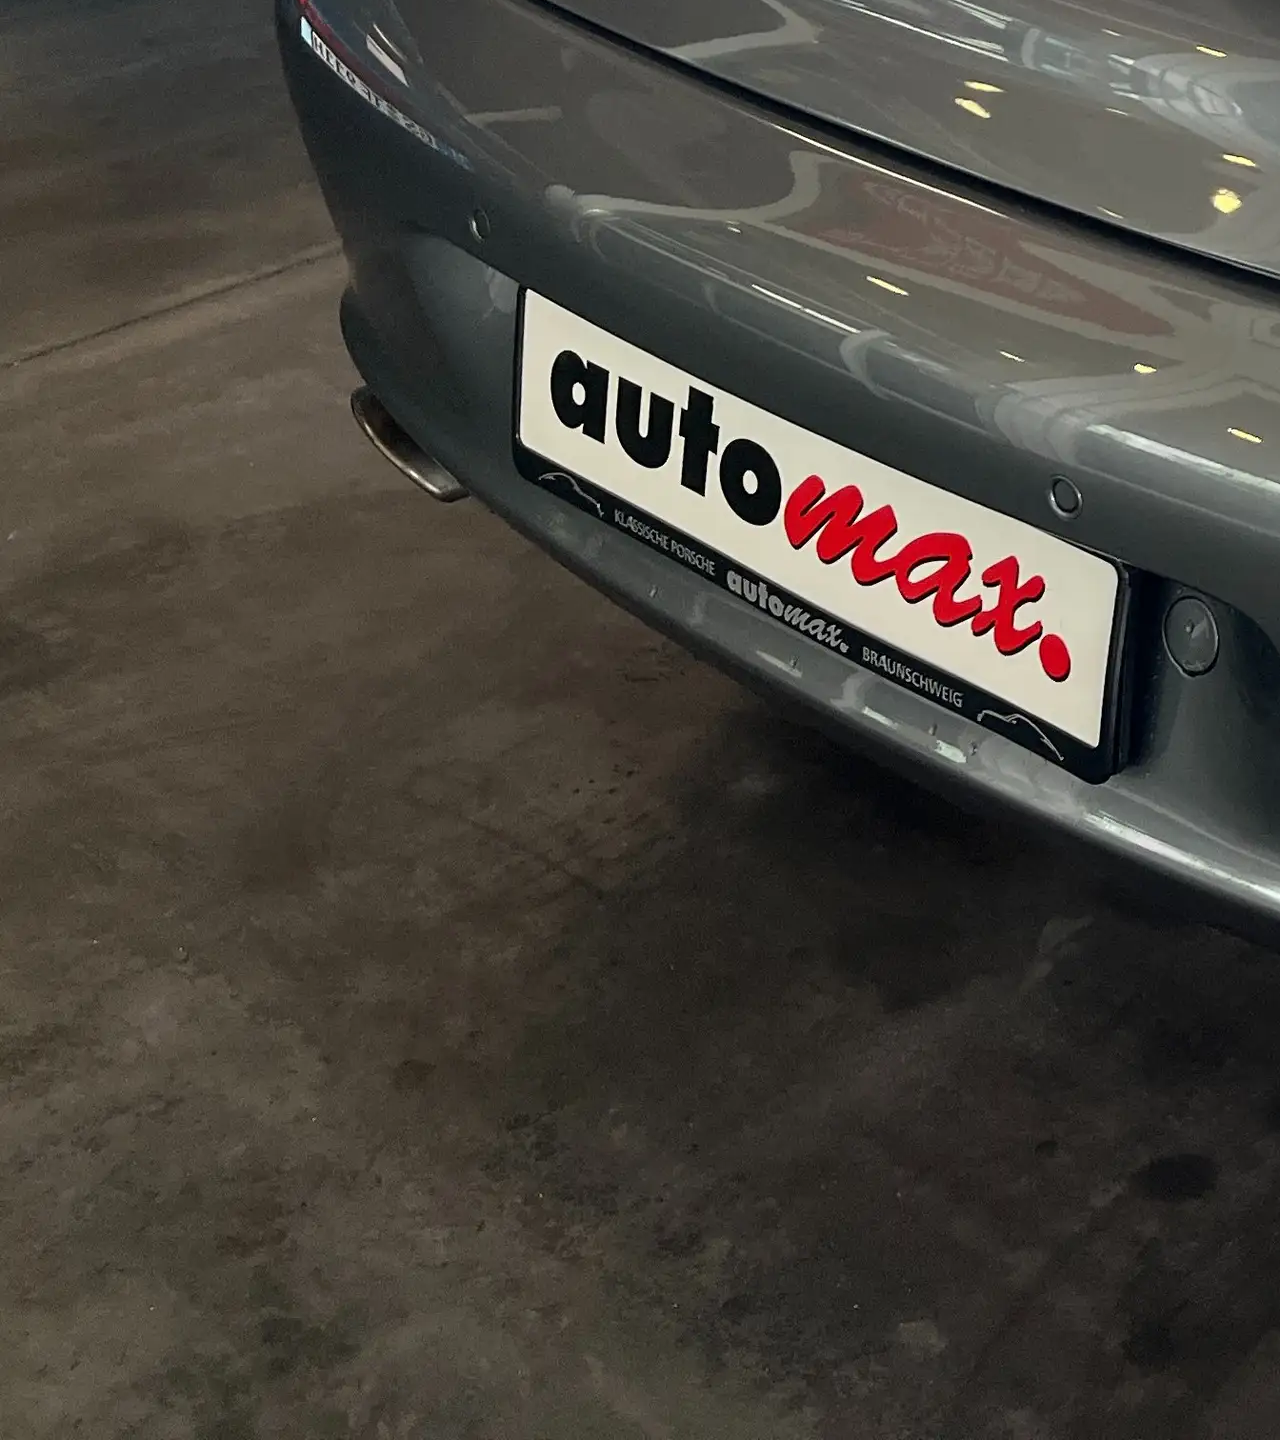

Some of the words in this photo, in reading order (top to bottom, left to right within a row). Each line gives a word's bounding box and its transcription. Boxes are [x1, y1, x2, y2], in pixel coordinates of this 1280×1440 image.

[614, 508, 669, 551] KLASSISCHE
[670, 541, 716, 577] PORSCHE
[862, 646, 965, 709] BRAUNSCHWEIG
